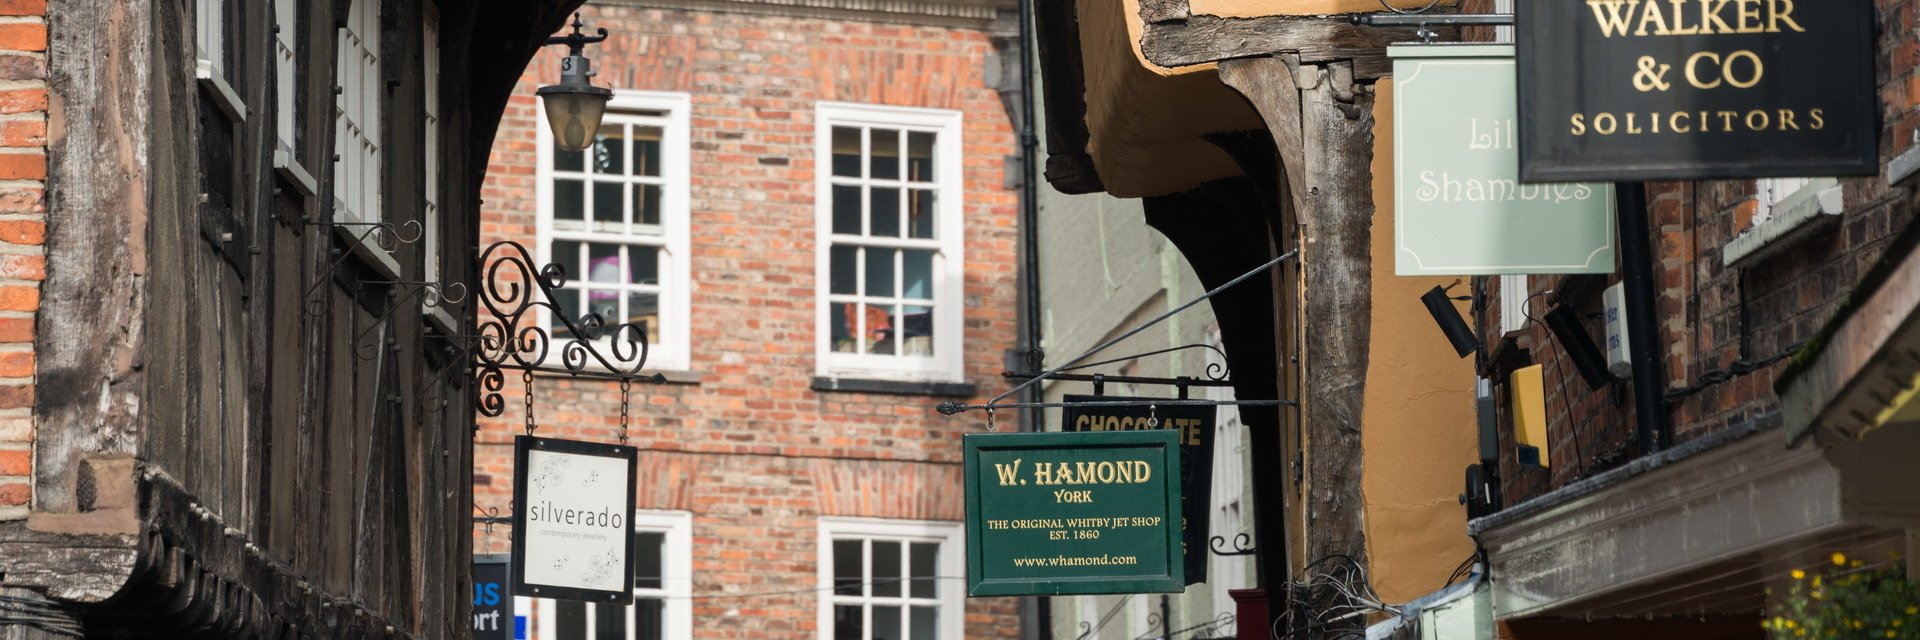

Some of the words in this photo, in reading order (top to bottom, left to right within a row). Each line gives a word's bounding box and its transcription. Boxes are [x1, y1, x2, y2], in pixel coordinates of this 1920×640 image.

[1586, 0, 1806, 38] WALKER
[562, 57, 572, 71] 3
[1632, 55, 1671, 92] &
[1684, 50, 1764, 90] CO
[1469, 118, 1514, 149] Lil
[1570, 108, 1825, 136] SOLICITORS
[1076, 415, 1201, 446] CHOCOTE
[995, 458, 1027, 486] W.
[1035, 460, 1152, 486] HAMOND
[1054, 488, 1093, 504] YORK
[530, 501, 622, 529] silverado
[988, 519, 1009, 530] THE
[1011, 518, 1064, 529] ORIGINAL
[1066, 517, 1111, 528] WHITBY
[1112, 517, 1130, 530] JET
[1132, 516, 1161, 527] SHOP
[540, 528, 581, 539] contemporary
[582, 531, 608, 542] jewellery
[1049, 531, 1070, 540] EST.
[1074, 529, 1100, 540] 1860
[1014, 554, 1138, 567] www.whamond.com
